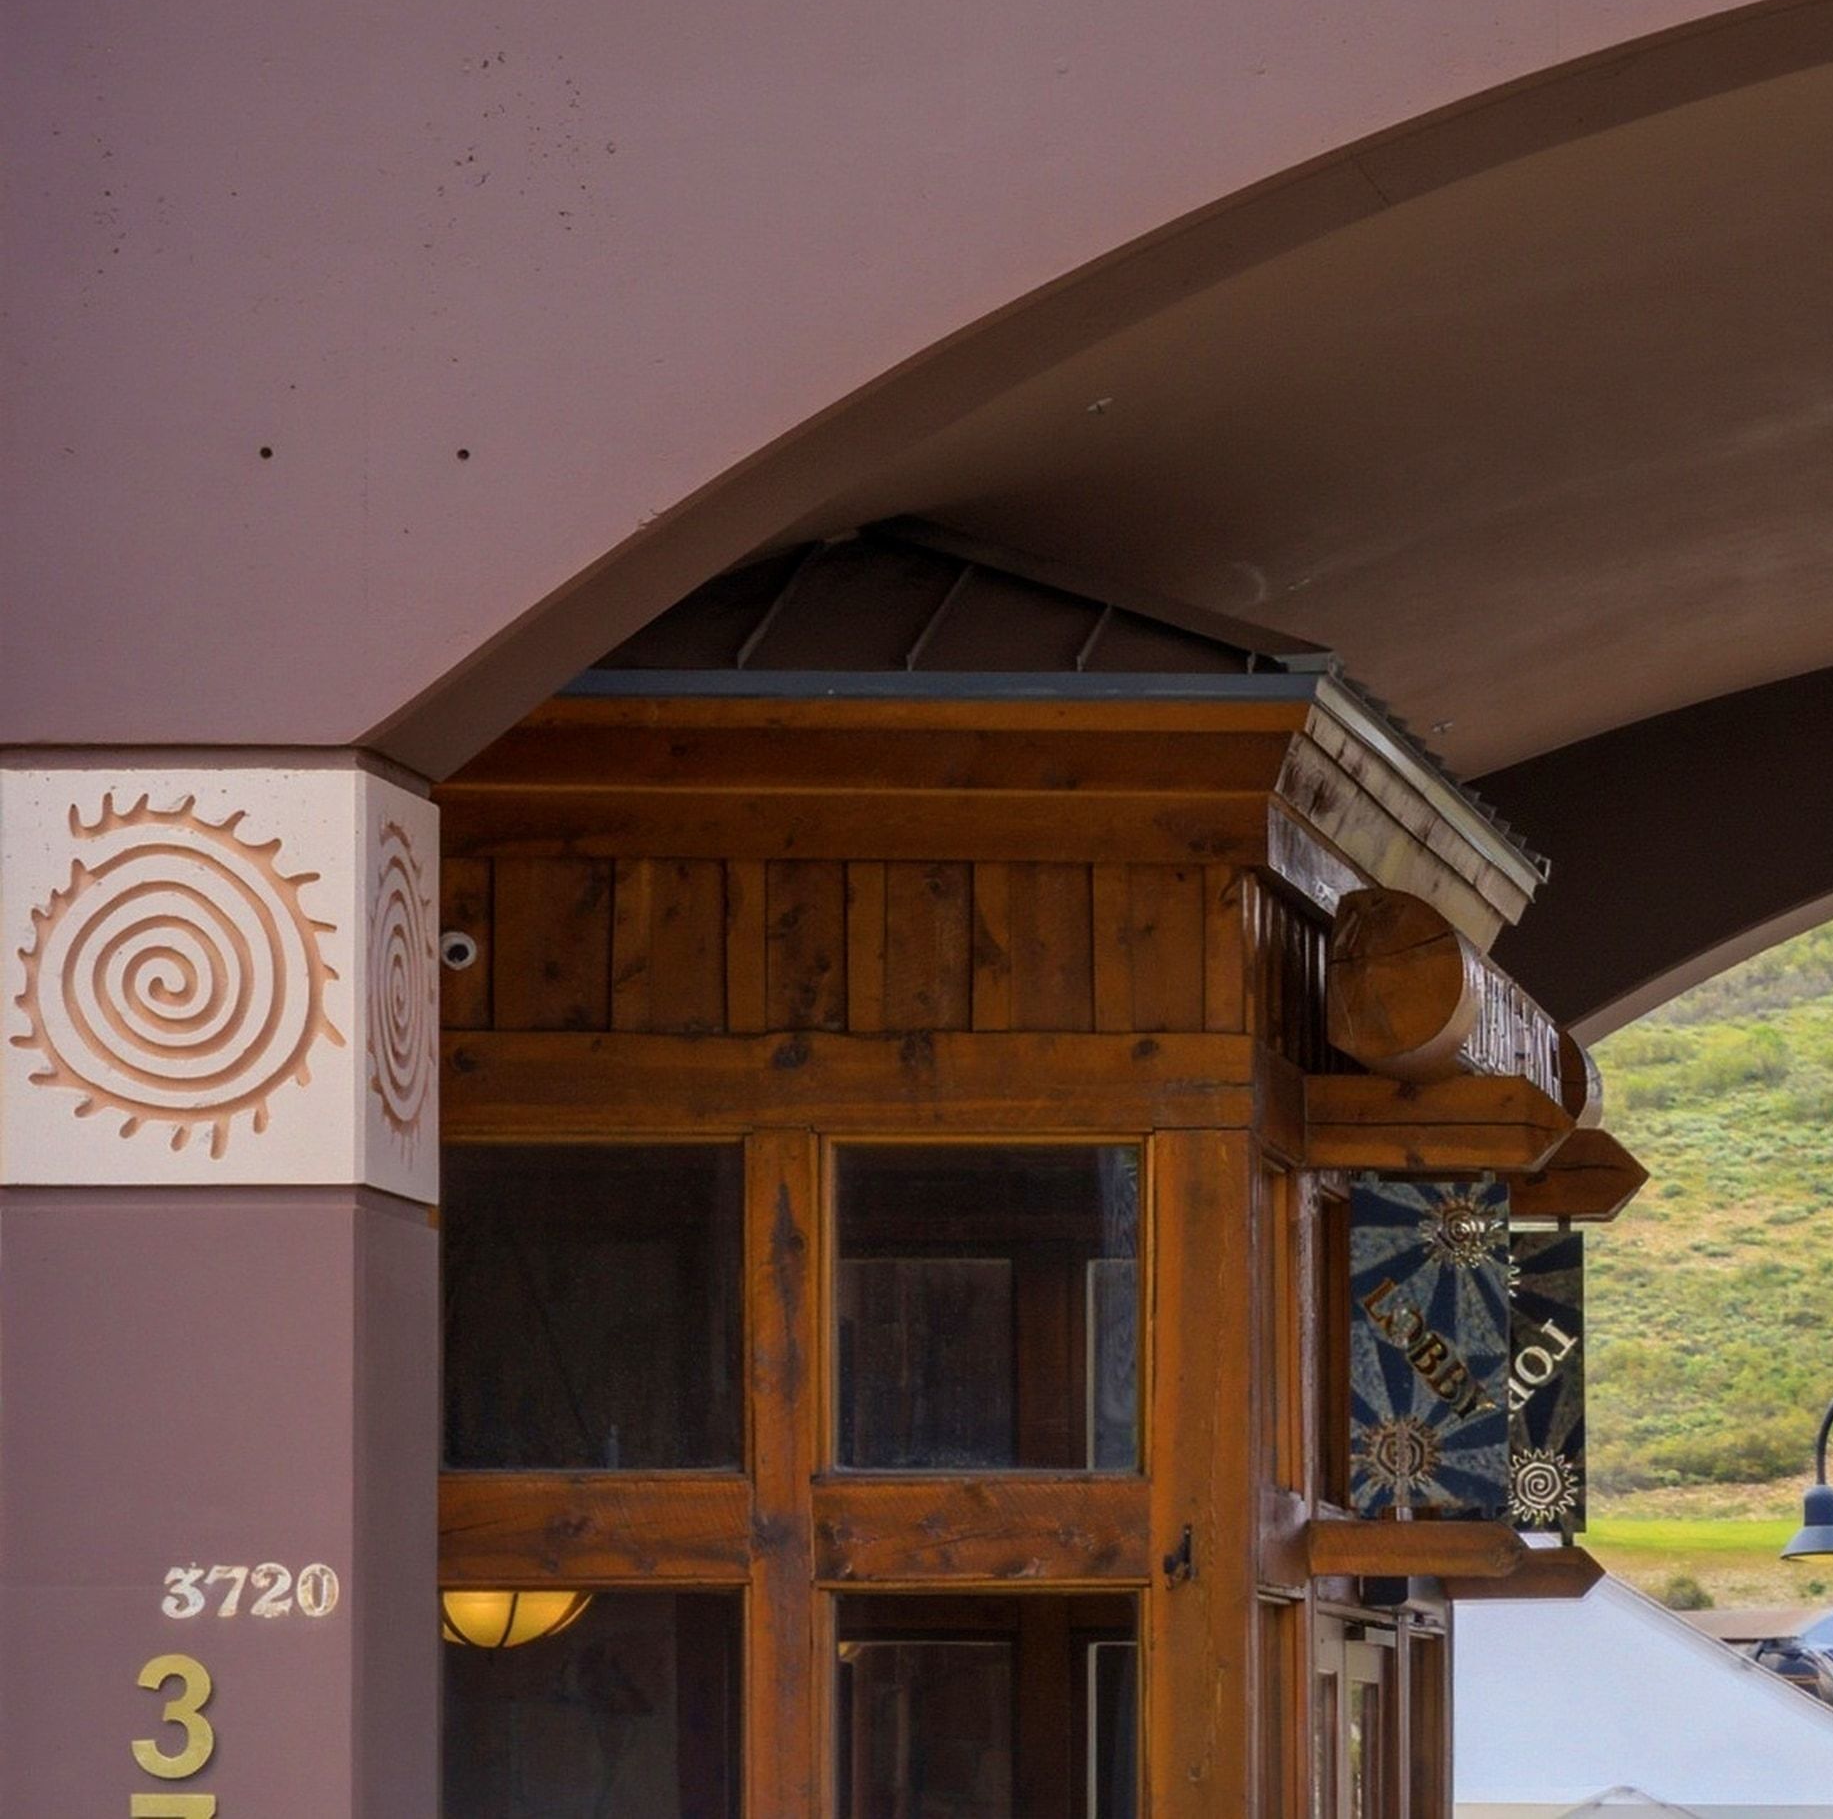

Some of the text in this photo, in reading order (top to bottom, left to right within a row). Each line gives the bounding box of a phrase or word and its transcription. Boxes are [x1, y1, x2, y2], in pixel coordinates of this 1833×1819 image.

[1361, 1277, 1498, 1420] LOBBY
[161, 1561, 340, 1619] 3720
[130, 1653, 217, 1819] 3
